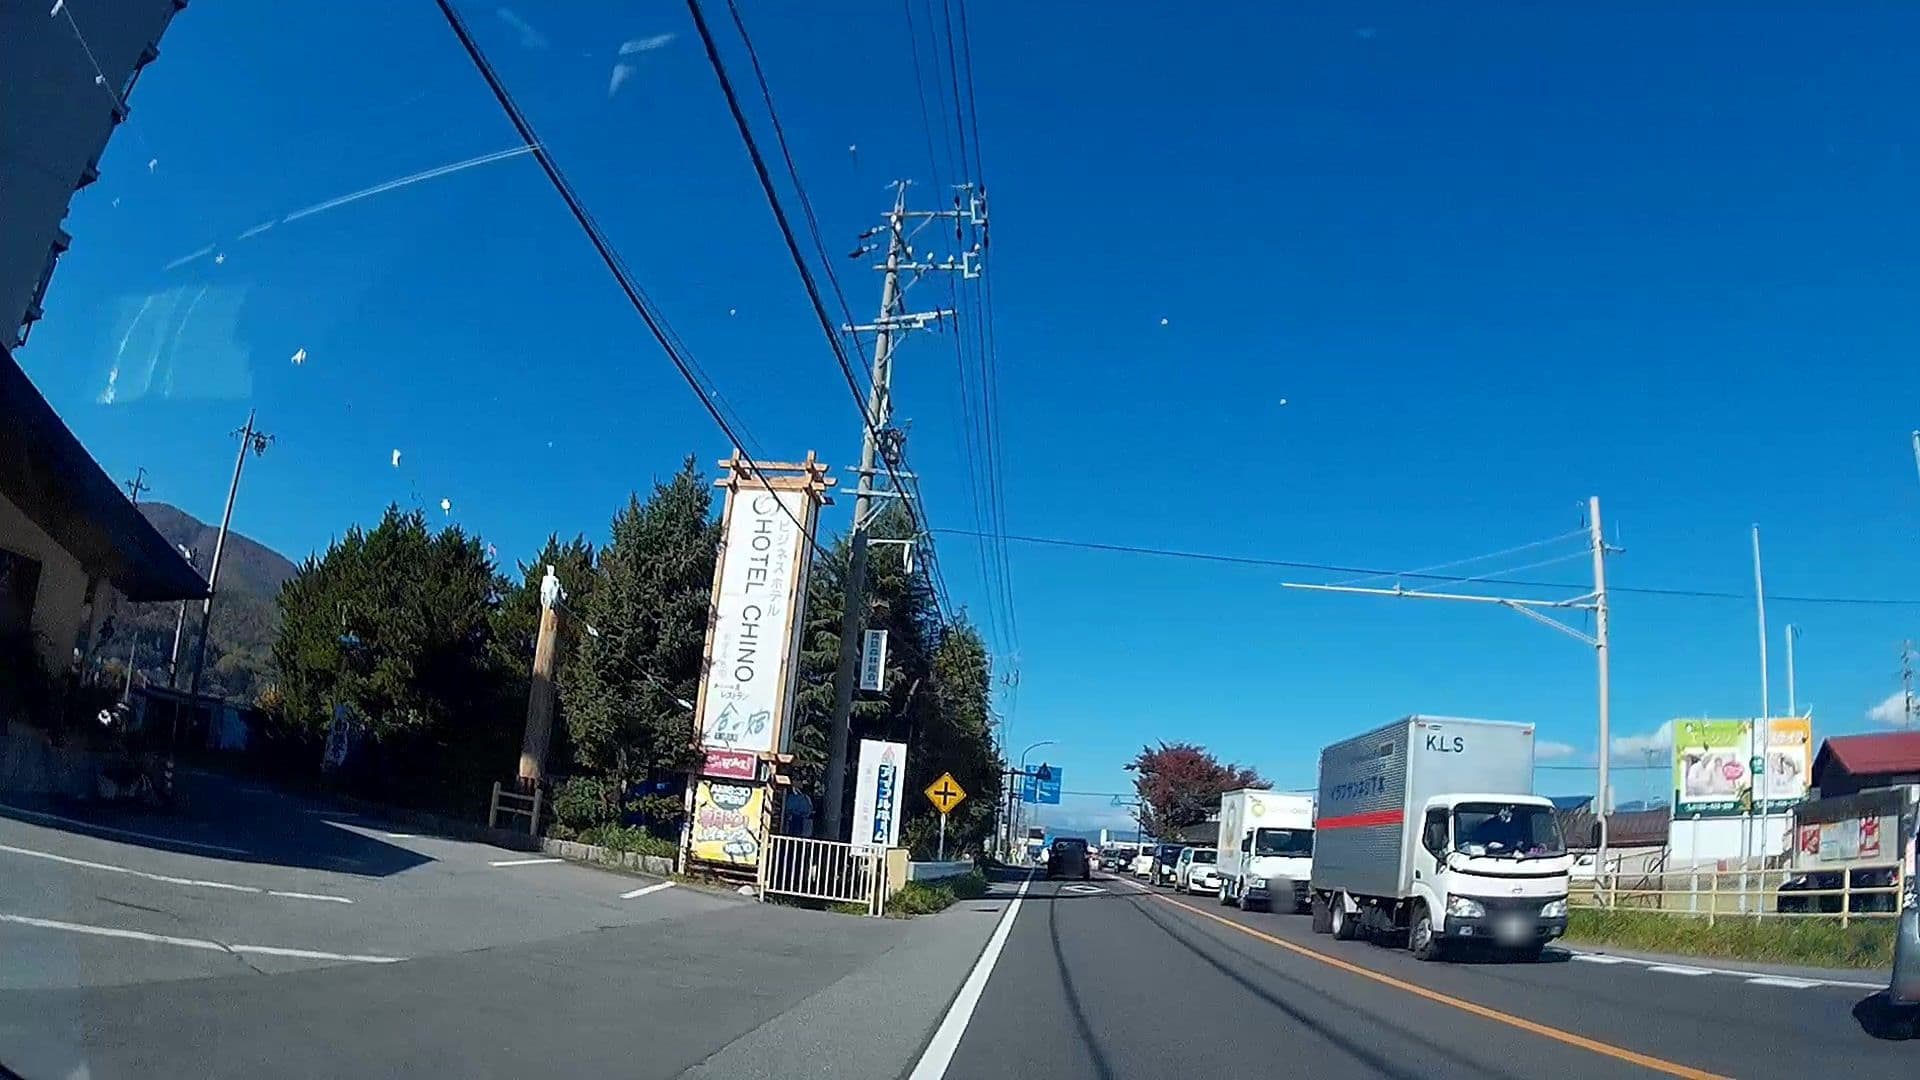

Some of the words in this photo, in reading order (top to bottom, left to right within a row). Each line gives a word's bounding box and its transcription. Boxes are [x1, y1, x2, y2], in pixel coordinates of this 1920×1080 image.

[745, 519, 772, 594] HOTEL
[767, 520, 790, 617] ビジネスホテル
[735, 605, 761, 682] CHINO
